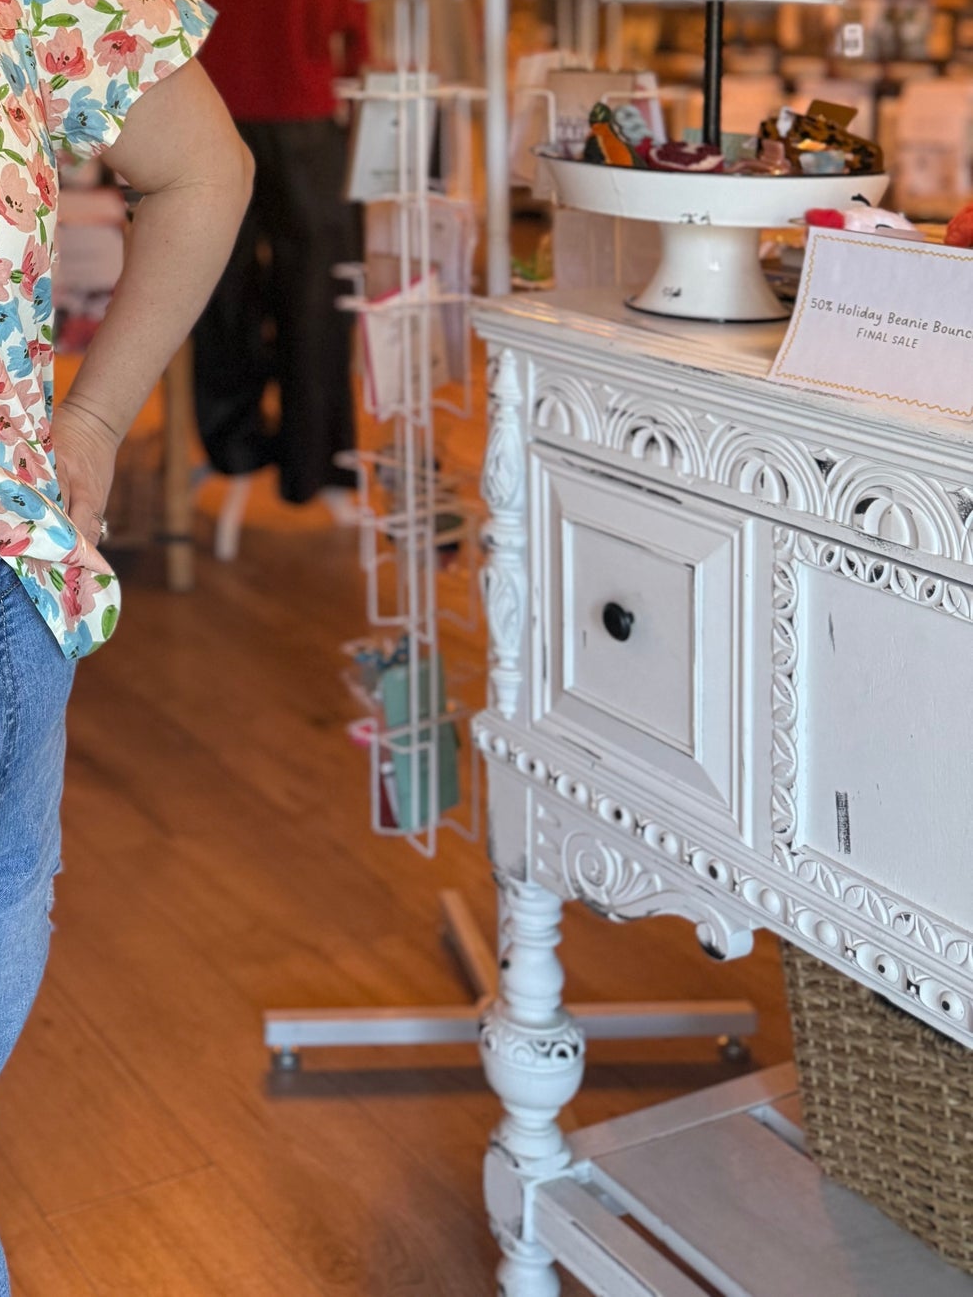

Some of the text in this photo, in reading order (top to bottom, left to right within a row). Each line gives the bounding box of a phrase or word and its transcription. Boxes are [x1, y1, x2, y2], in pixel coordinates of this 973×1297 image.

[810, 297, 973, 339] 50% Holiday Beanie Bounc
[856, 327, 919, 349] FINAL SALE
